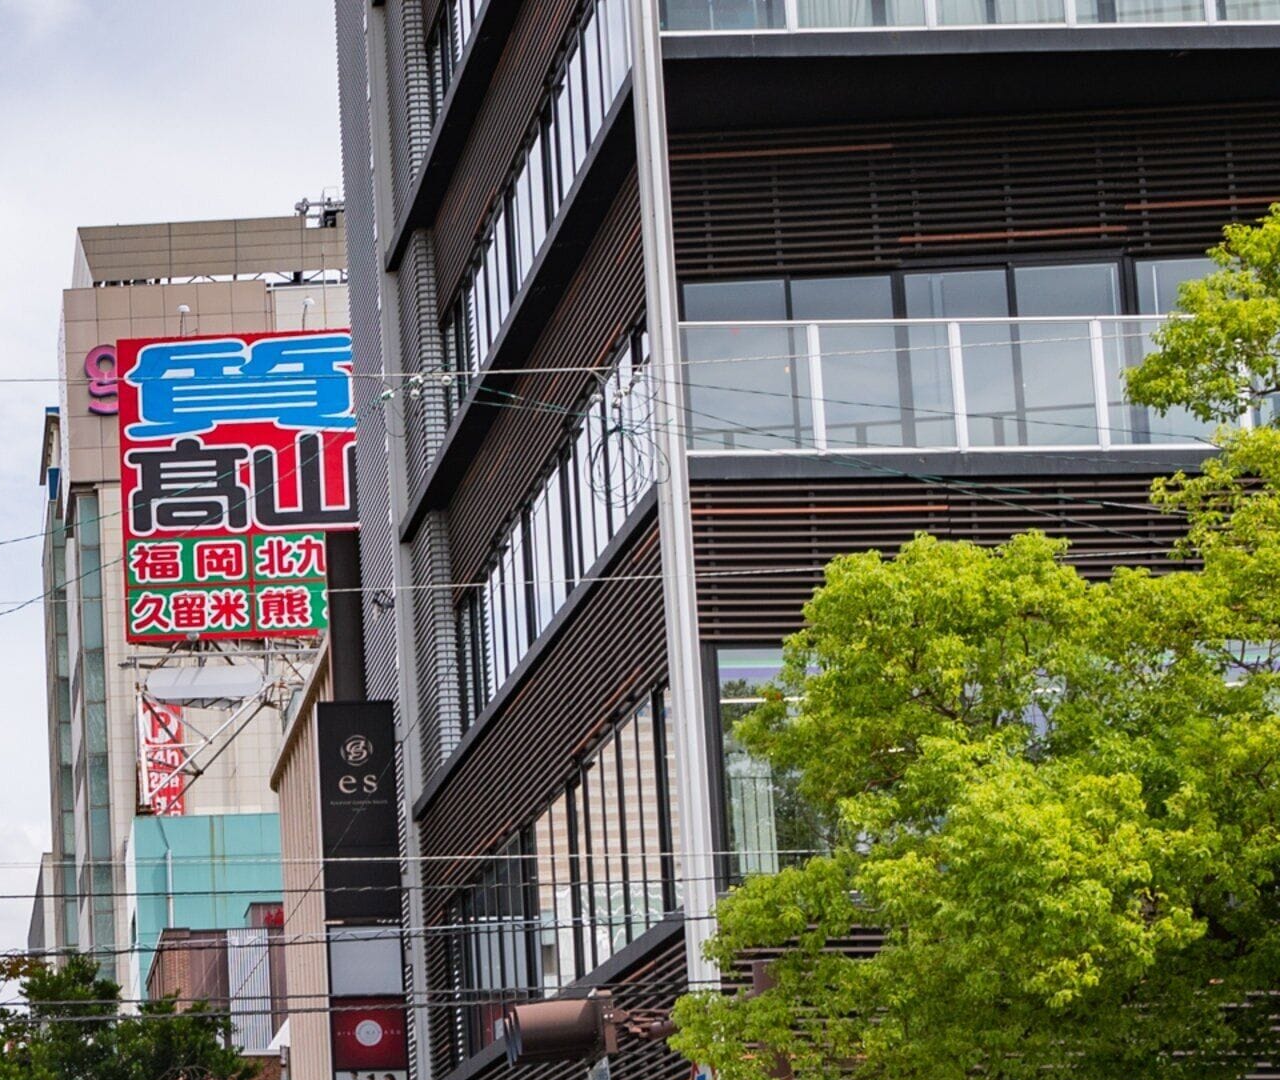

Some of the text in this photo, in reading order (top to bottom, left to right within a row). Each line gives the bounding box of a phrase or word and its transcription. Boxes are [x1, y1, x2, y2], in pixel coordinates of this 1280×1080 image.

[131, 541, 245, 581] 福岡
[132, 590, 248, 630] 久留米
[260, 588, 328, 626] 熊
[338, 774, 377, 794] es
